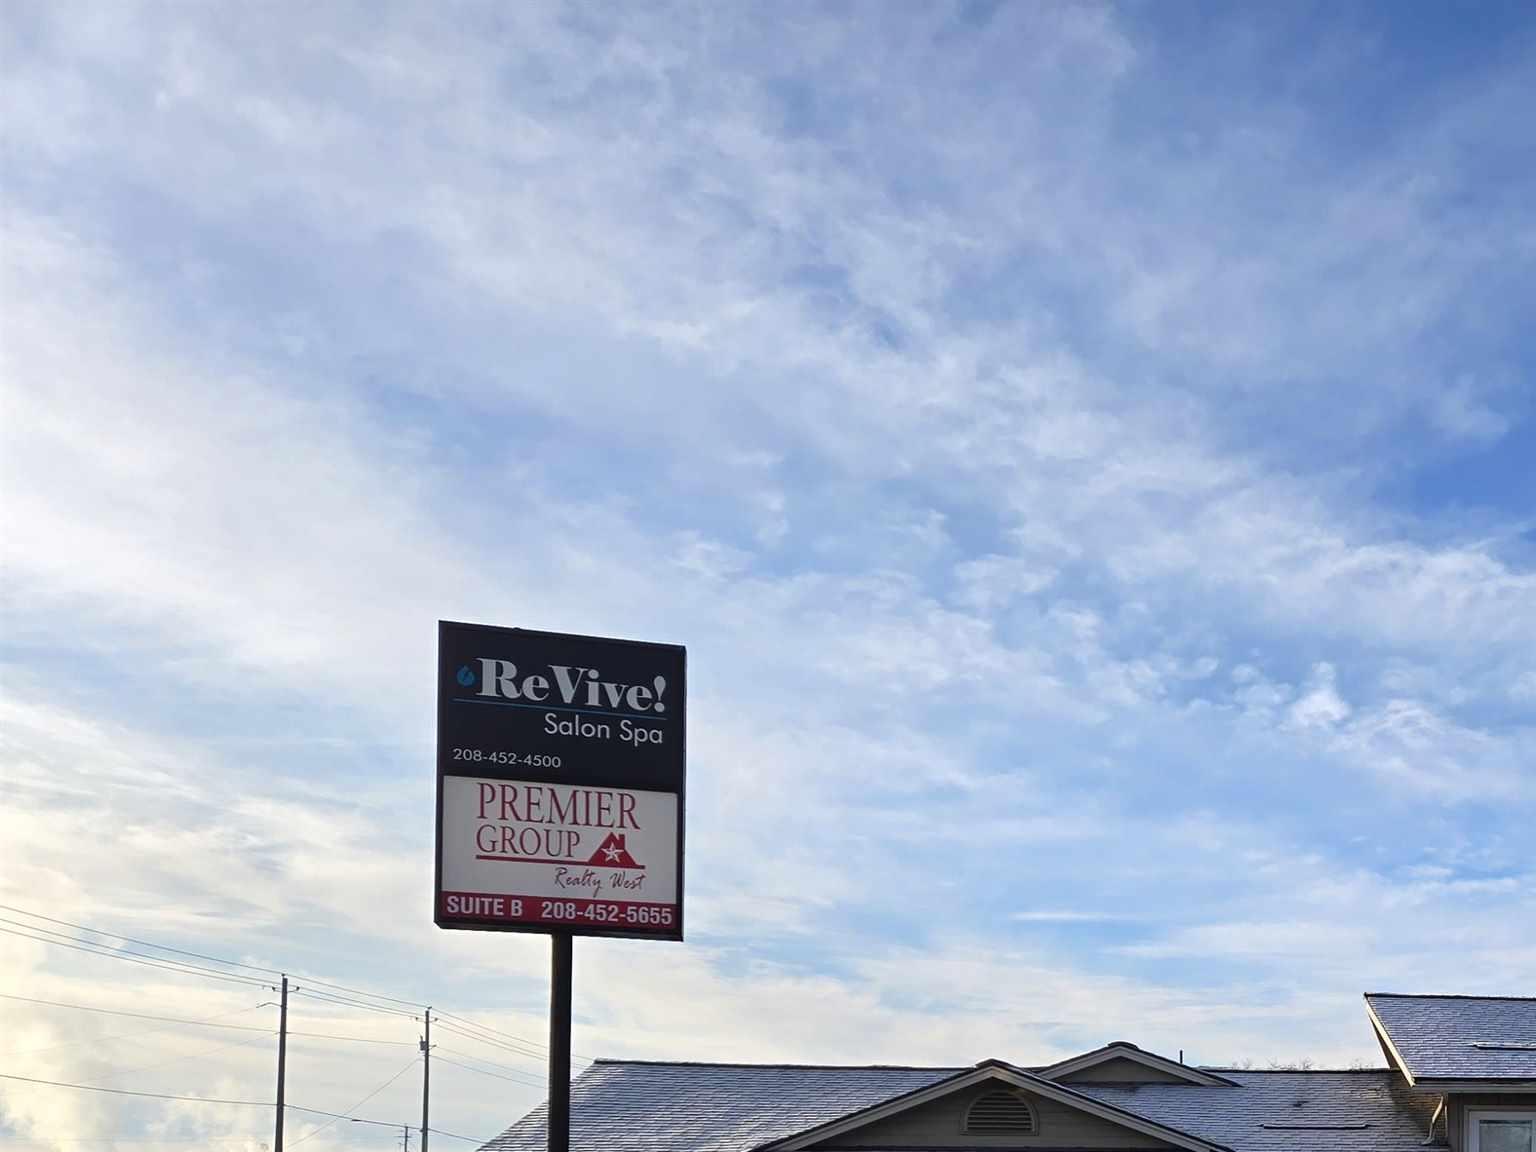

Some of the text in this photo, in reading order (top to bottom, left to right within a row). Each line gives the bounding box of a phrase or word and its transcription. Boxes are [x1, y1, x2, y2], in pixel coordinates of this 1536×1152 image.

[475, 657, 667, 713] ReVive!
[544, 712, 664, 747] Salon Spa
[453, 748, 562, 768] 208-452-4500
[476, 782, 641, 830] PREMIER
[476, 824, 581, 858] GROUP
[554, 867, 647, 898] Realty West
[447, 895, 673, 925] SUITE B 208-452-5655
